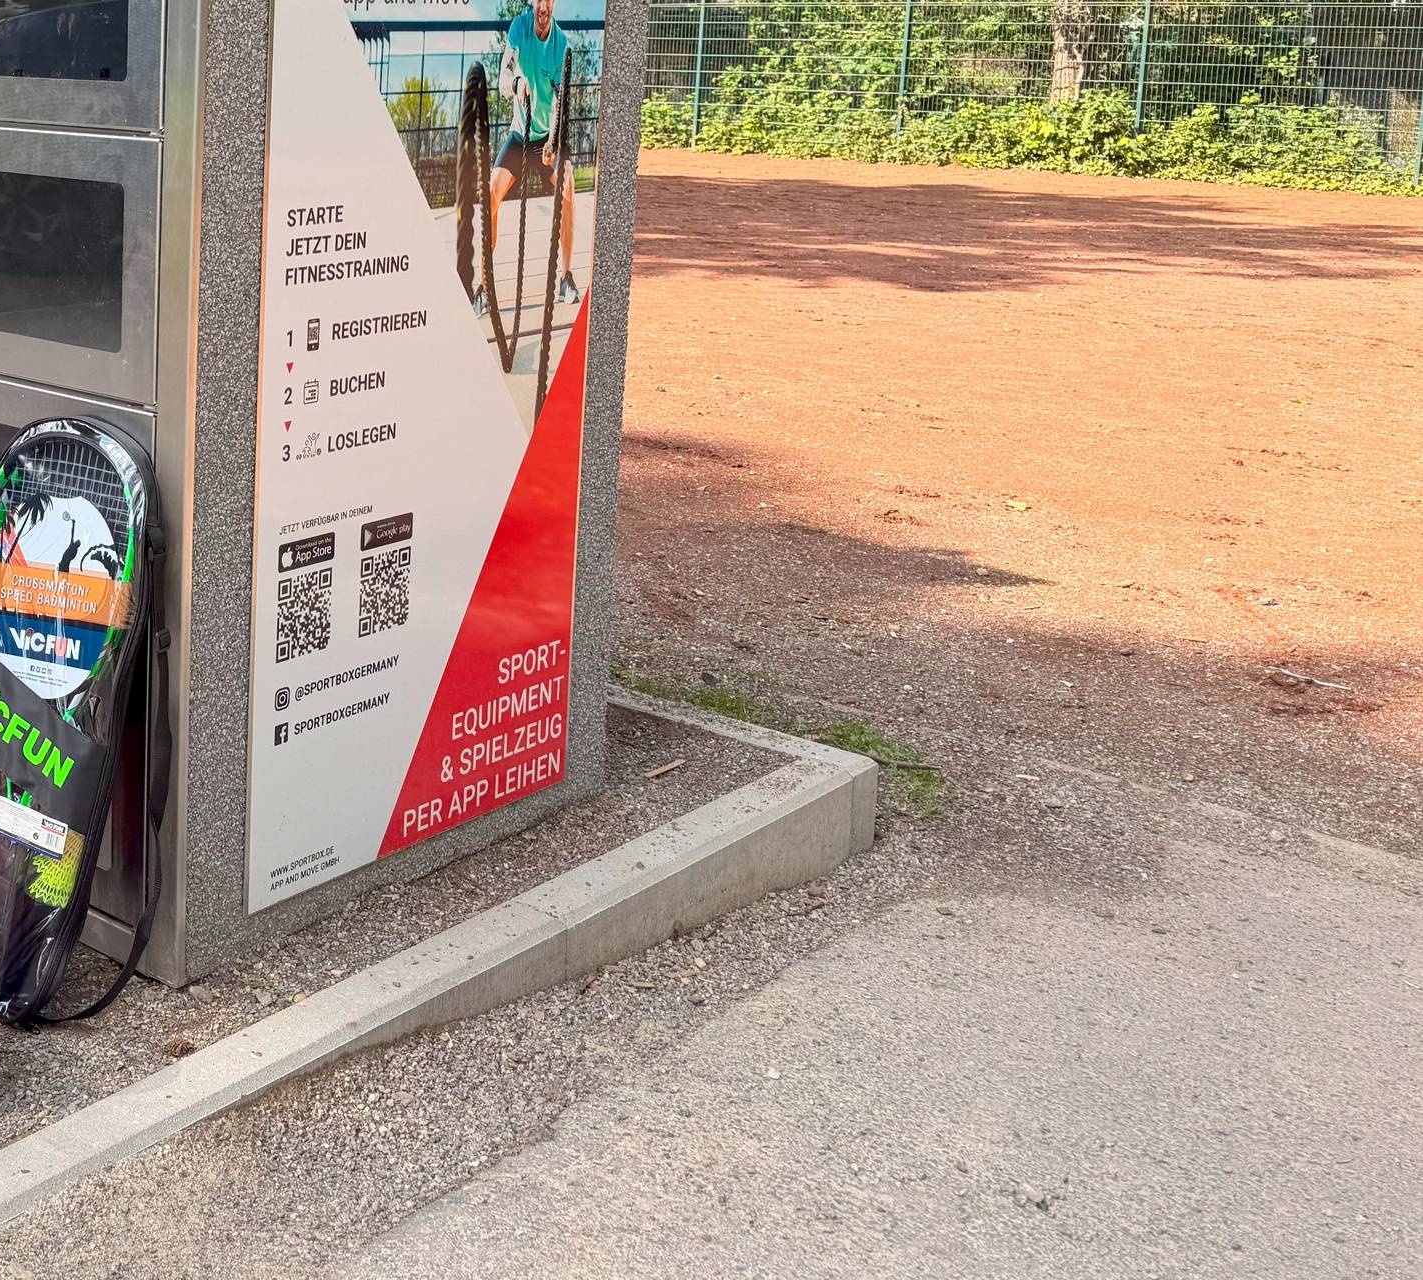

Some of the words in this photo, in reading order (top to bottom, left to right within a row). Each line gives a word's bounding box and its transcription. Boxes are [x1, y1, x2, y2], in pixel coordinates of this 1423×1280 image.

[287, 205, 344, 227] STARTE
[286, 235, 331, 256] JETZT
[335, 231, 367, 252] DEIN
[285, 255, 409, 286] FITNESSTRAINING
[286, 330, 294, 347] 1
[331, 310, 427, 341] REGISTRIEREN
[284, 387, 293, 405] 2
[329, 371, 386, 397] BUCHEN
[282, 445, 291, 463] 3
[328, 423, 397, 454] LOSLEGEN
[279, 523, 300, 535] JETZT
[301, 512, 340, 529] VERFÜGBAR
[340, 510, 347, 520] IN
[348, 505, 373, 518] DEINEM
[377, 527, 398, 540] Google
[295, 550, 312, 564] App
[312, 545, 332, 559] Store
[1, 587, 33, 603] SPEED
[37, 593, 96, 614] BADMINTON
[12, 575, 89, 597] CROSSMINTON/
[295, 655, 399, 701] @SPORTBOXGERMANY
[498, 639, 566, 684] SPORT-
[294, 693, 390, 735] SPORTBOXGERMANY
[452, 675, 564, 740] EQUIPMENT
[441, 757, 453, 782] &
[460, 713, 562, 776] SPIELZEUG
[403, 799, 443, 837] PER
[448, 780, 489, 818] APP
[495, 750, 560, 800] LEIHEN
[270, 845, 334, 878] WWW.SPORTBOX.DE
[270, 879, 283, 892] APP
[285, 873, 299, 885] AND
[301, 864, 319, 879] MOVE
[321, 856, 340, 870] GMBH
